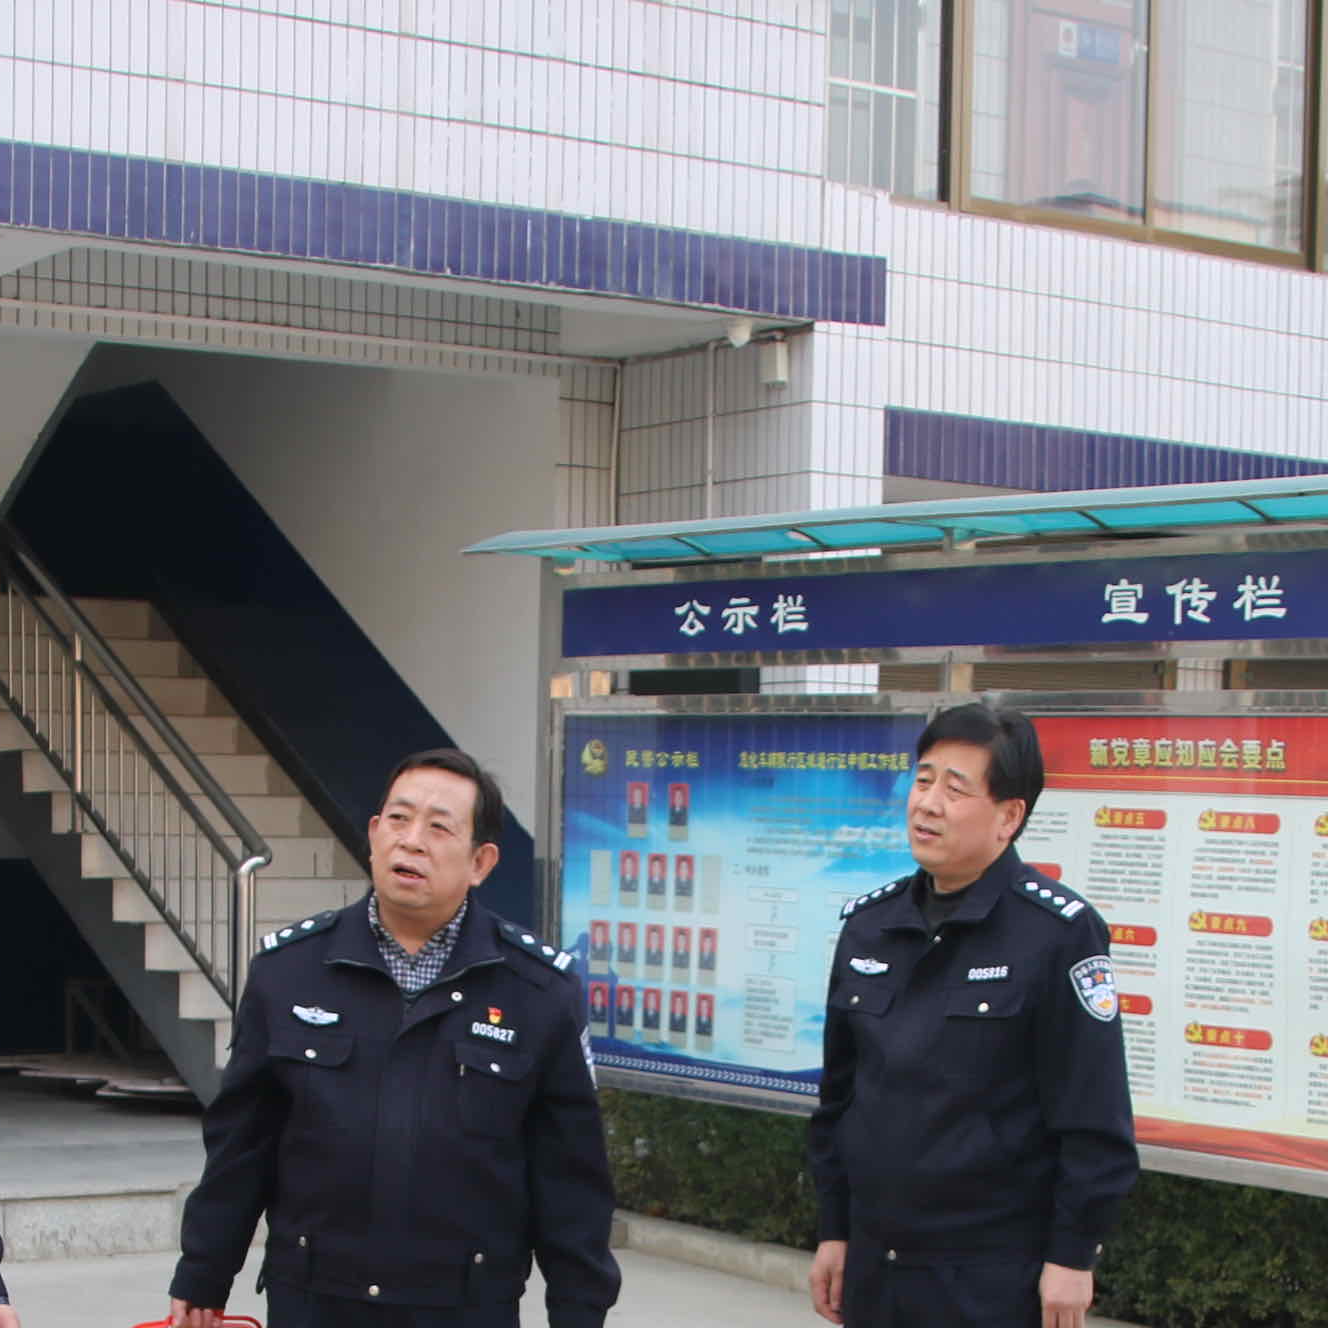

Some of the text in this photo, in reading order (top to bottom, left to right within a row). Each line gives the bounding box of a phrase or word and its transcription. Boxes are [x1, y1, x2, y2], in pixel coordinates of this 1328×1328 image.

[674, 593, 810, 637] 公示栏
[1099, 573, 1289, 626] 宣传栏
[1089, 738, 1287, 772] 新党章应知应会要点
